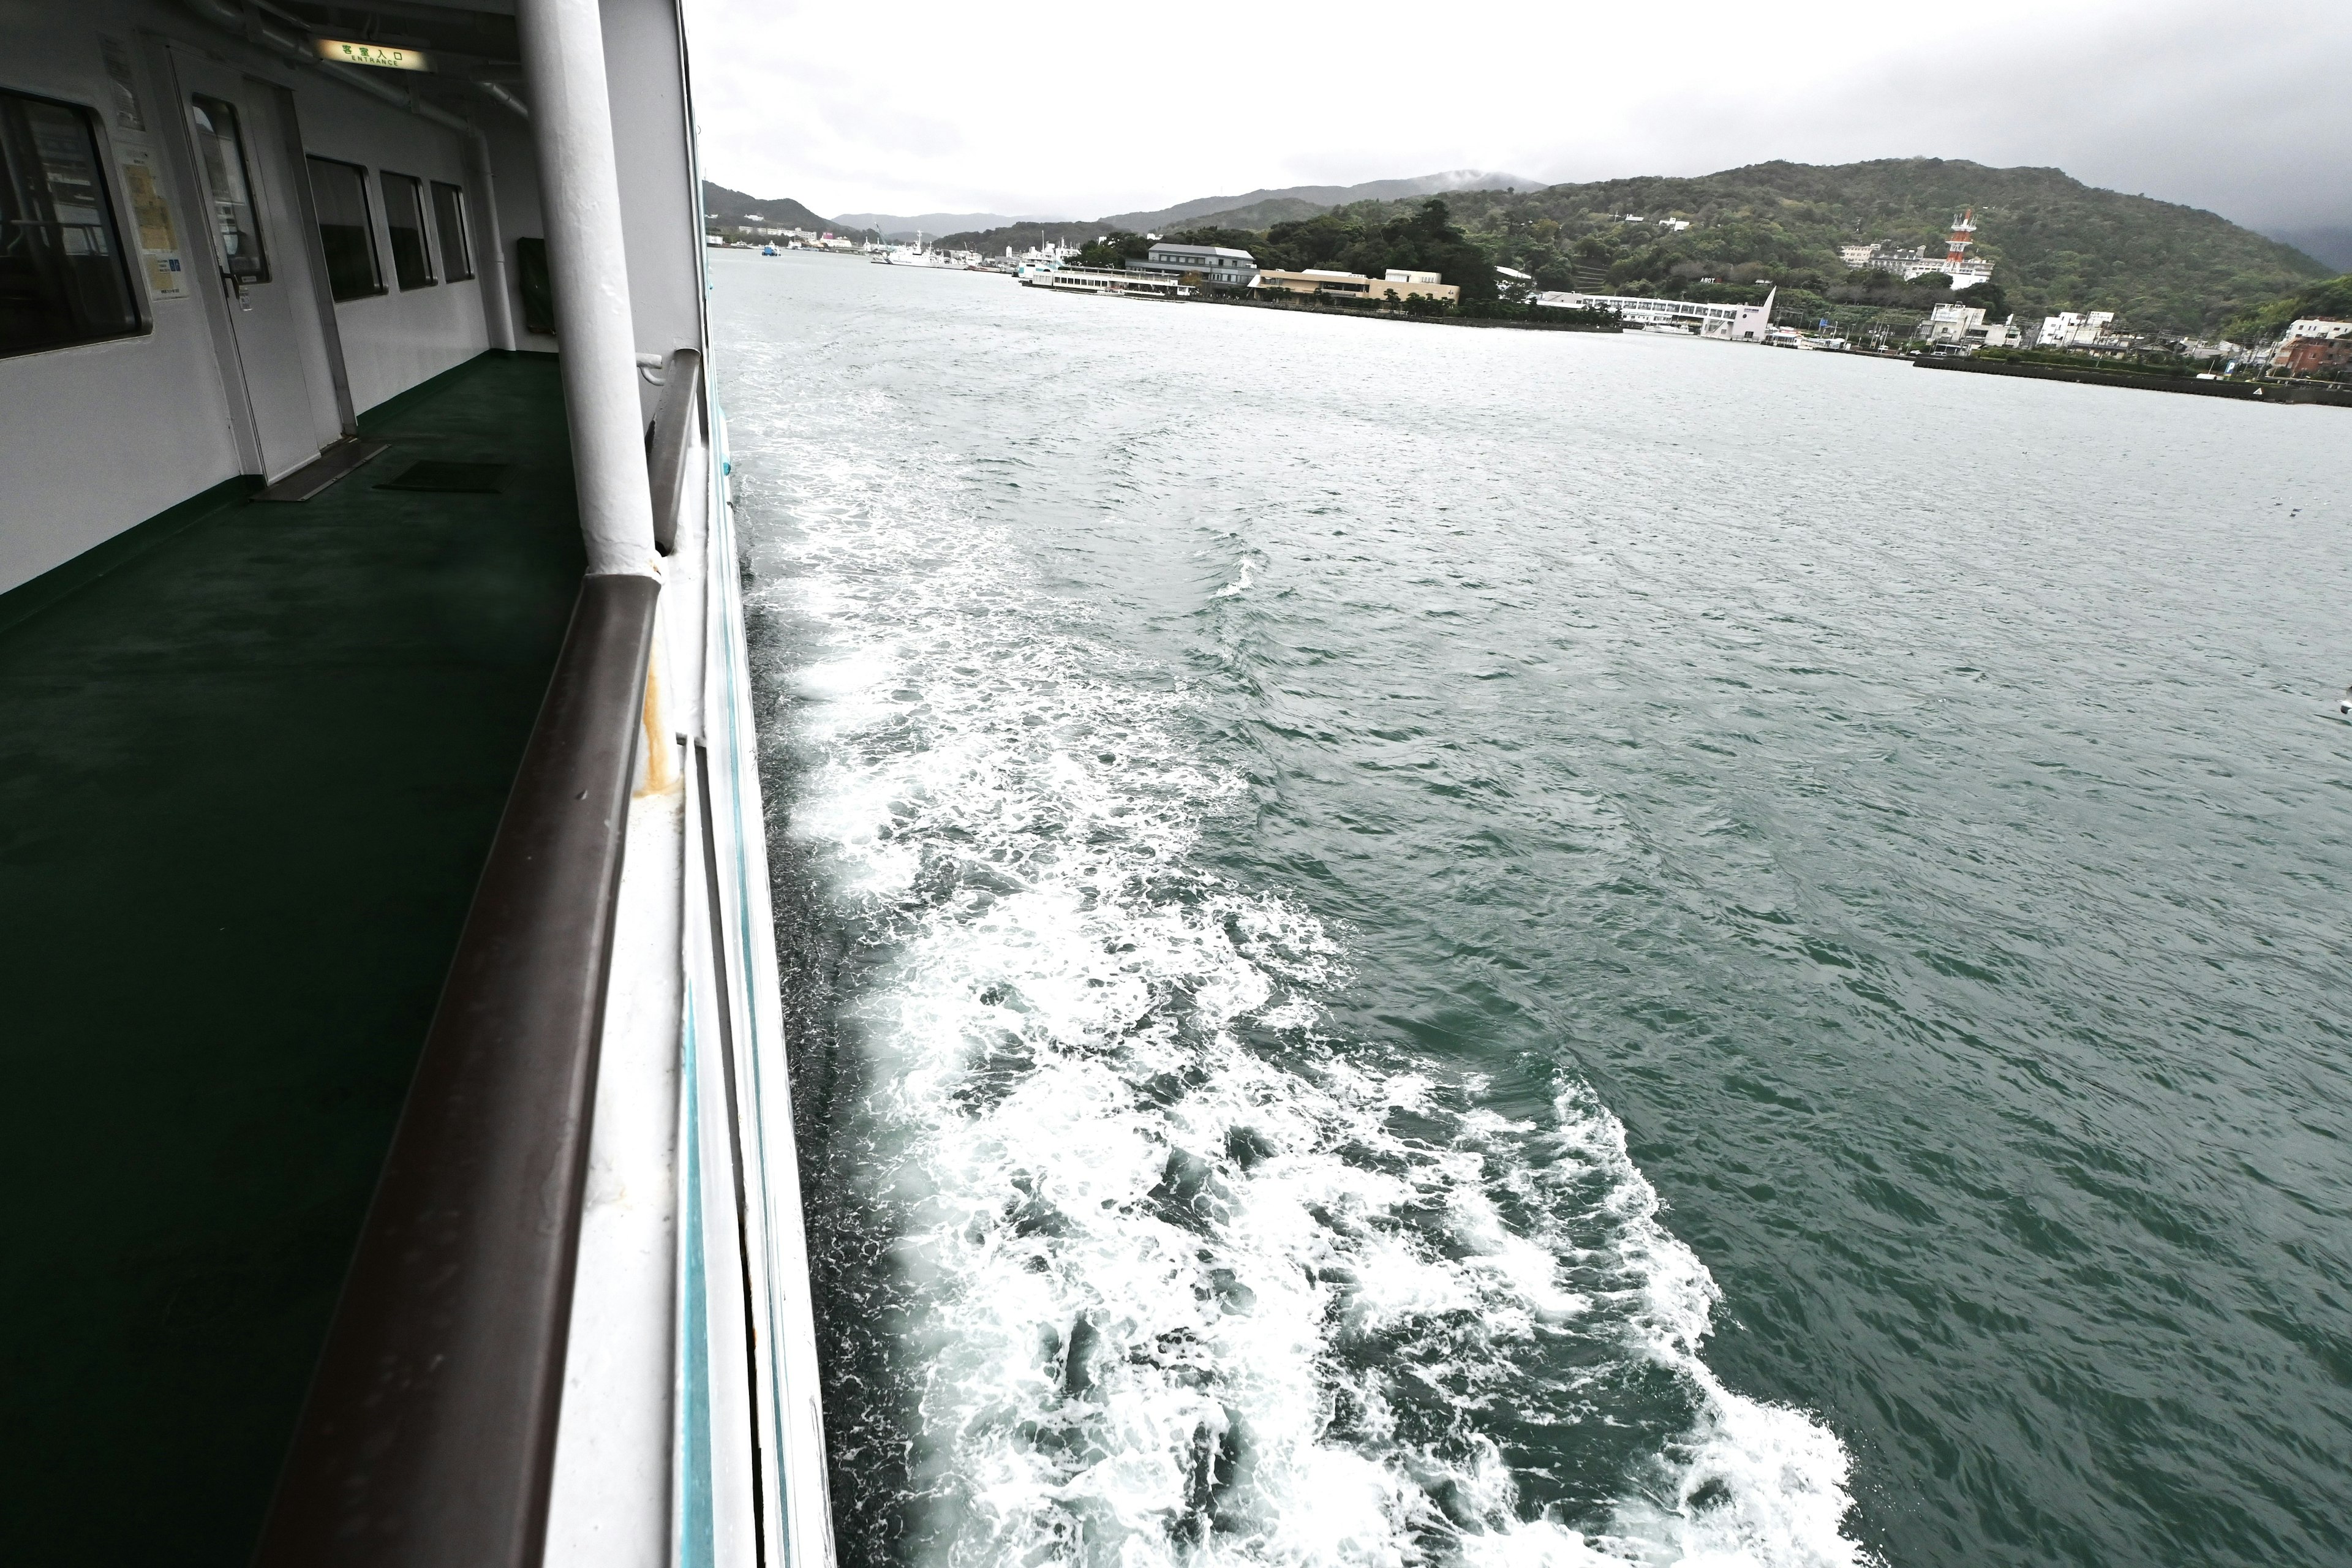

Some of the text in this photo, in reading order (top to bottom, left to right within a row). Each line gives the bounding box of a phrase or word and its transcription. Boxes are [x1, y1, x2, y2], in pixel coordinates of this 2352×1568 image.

[342, 45, 402, 61] 客室入口
[352, 56, 398, 66] ENTRANCE
[2226, 362, 2236, 373] P
